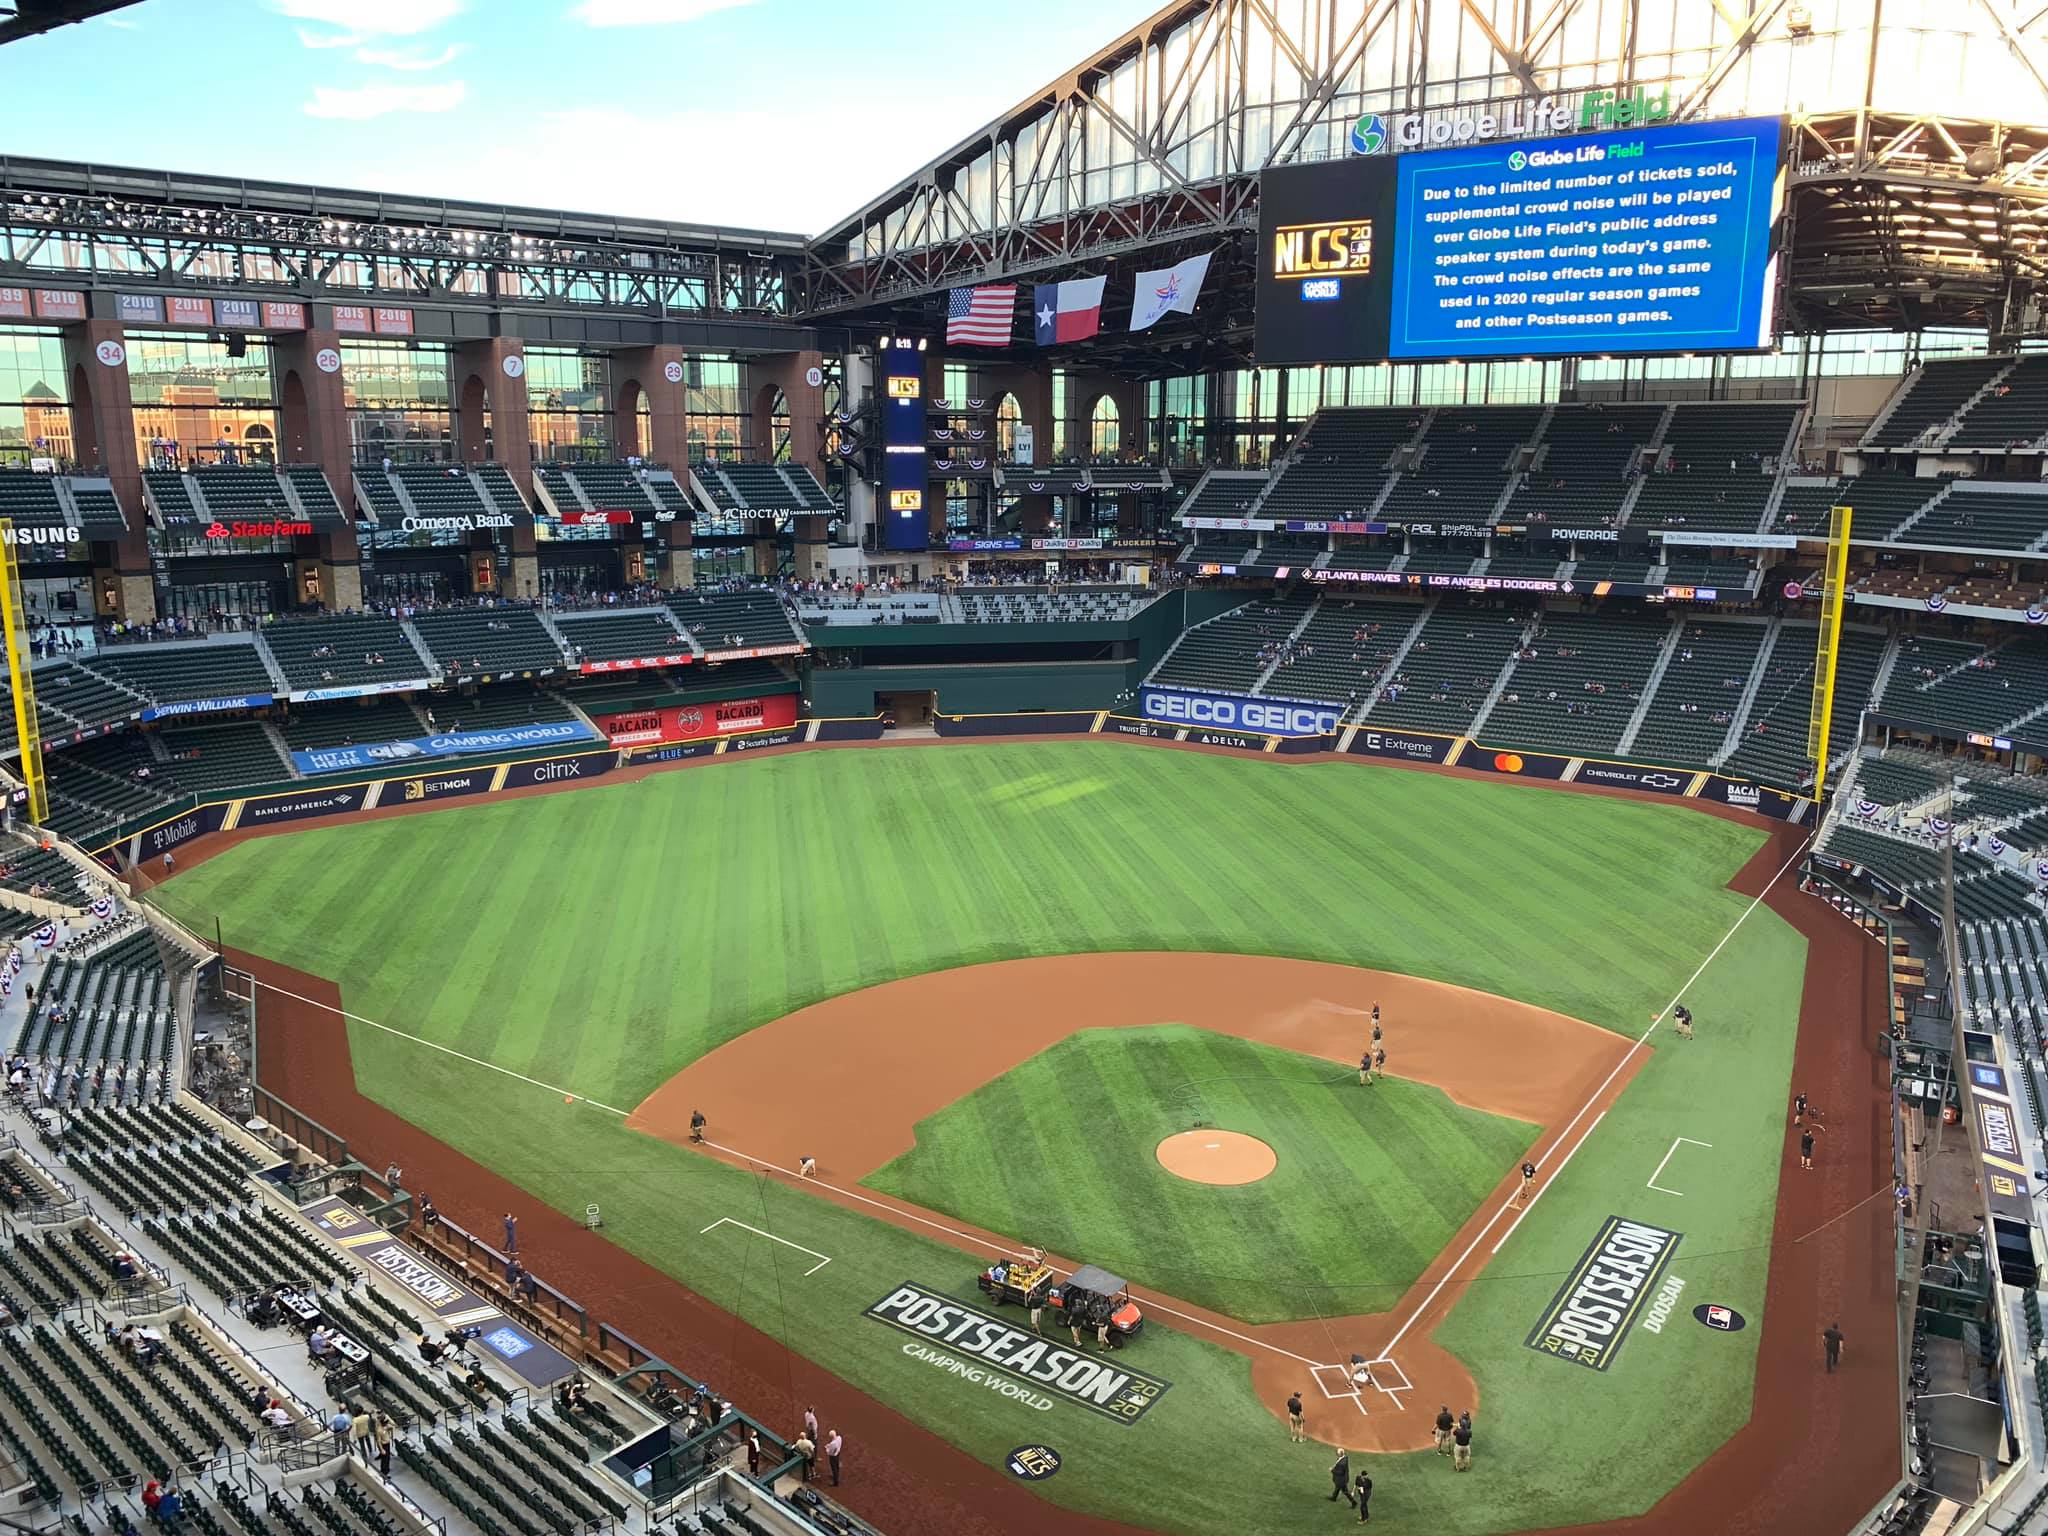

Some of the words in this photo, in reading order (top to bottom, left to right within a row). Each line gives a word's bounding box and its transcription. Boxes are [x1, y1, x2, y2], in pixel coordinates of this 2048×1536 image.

[1396, 113, 1498, 147] Globe
[1507, 96, 1573, 136] Life
[1582, 83, 1669, 128] Field
[1528, 150, 1574, 168] Globe
[1575, 145, 1605, 163] Life
[1607, 142, 1644, 160] Field
[1424, 188, 1450, 201] Due
[1454, 187, 1469, 199] to
[1473, 184, 1496, 197] the
[1500, 178, 1551, 194] limited
[1556, 172, 1613, 189] number
[1617, 171, 1634, 184] of
[1639, 167, 1692, 182] tickets
[1697, 162, 1737, 177] sold,
[1425, 203, 1520, 223] supplemental
[1524, 200, 1569, 215] crowd
[1573, 197, 1615, 211] noise
[1619, 193, 1647, 207] will
[1652, 192, 1672, 205] be
[1677, 186, 1732, 206] played
[1351, 226, 1372, 241] 20
[1434, 231, 1464, 243] over
[1468, 227, 1510, 241] Globe
[1514, 225, 1542, 238] Life
[1546, 221, 1596, 236] Field’s
[1601, 217, 1649, 234] public
[1653, 213, 1717, 228] address
[1275, 227, 1349, 273] NLCS
[1435, 251, 1491, 267] speaker
[1494, 248, 1544, 263] system
[1549, 244, 1597, 259] during
[1602, 240, 1658, 255] today’s
[1663, 238, 1712, 253] game.
[1350, 254, 1371, 268] 20
[1434, 275, 1458, 287] The
[1462, 272, 1504, 285] crowd
[1508, 269, 1548, 282] noise
[1552, 266, 1604, 280] effects
[1608, 265, 1634, 277] are
[1638, 263, 1663, 275] the
[1667, 261, 1711, 274] same
[42, 291, 77, 305] 2010
[1304, 287, 1338, 299] WORLD
[1440, 295, 1472, 308] used
[1477, 294, 1489, 306] in
[1494, 292, 1527, 305] 2020
[1532, 290, 1584, 305] regular
[1588, 288, 1643, 301] season
[1648, 286, 1700, 300] games
[123, 296, 154, 309] 2010
[175, 298, 204, 312] 2011
[222, 301, 251, 314] 2011
[269, 303, 299, 316] 2012
[336, 306, 364, 319] 2015
[1456, 316, 1481, 329] and
[1485, 315, 1523, 327] other
[1527, 311, 1612, 326] Postseason
[1617, 310, 1673, 325] games.
[100, 346, 122, 361] 34
[319, 354, 338, 368] 26
[509, 360, 519, 373] 7
[667, 367, 681, 378] 29
[809, 371, 819, 382] 10
[476, 513, 514, 528] Bank
[729, 508, 790, 519] CHOCTAW
[1303, 522, 1327, 531] 105.3
[1411, 524, 1436, 534] PGL
[1551, 528, 1619, 541] POWERADE
[1113, 539, 1157, 547] PLUCKERS
[1314, 569, 1359, 581] ATLANTA
[1360, 571, 1401, 583] BRAVES
[1407, 574, 1421, 584] VS
[1428, 576, 1450, 586] LOS
[1451, 577, 1501, 588] ANGELES
[1503, 578, 1557, 591] DODGERS
[1145, 693, 1235, 721] GEICO
[1242, 703, 1338, 735] GEICO
[430, 729, 511, 749] CAMPING
[511, 725, 574, 742] WORLD
[1119, 725, 1139, 734] TRUIST
[745, 738, 768, 749] Security
[769, 735, 790, 745] Benefit
[1212, 735, 1246, 748] DELTA
[1385, 737, 1433, 753] Extreme
[311, 752, 340, 764] HIT
[343, 750, 357, 760] IT
[660, 748, 682, 760] BLUE
[315, 757, 361, 770] HERE
[533, 759, 581, 782] citrix
[1586, 768, 1637, 781] CHEVROLET
[425, 777, 471, 793] BETMGM
[255, 807, 280, 818] BANK
[282, 805, 293, 813] OF
[295, 799, 335, 812] AMERICA
[371, 1246, 454, 1304] POSTSEASON
[1550, 1220, 1670, 1350] POSTSEASON
[1642, 1275, 1687, 1335] DOOSAN
[490, 1334, 522, 1354] WORLD
[872, 1286, 1130, 1405] POSTSEASON
[1541, 1335, 1560, 1353] 20
[1577, 1347, 1600, 1366] 20
[902, 1342, 986, 1383] CAMPING
[984, 1374, 1055, 1413] WORLD
[1130, 1380, 1160, 1397] 20
[1109, 1400, 1140, 1416] 20
[1016, 1448, 1051, 1476] NLCS
